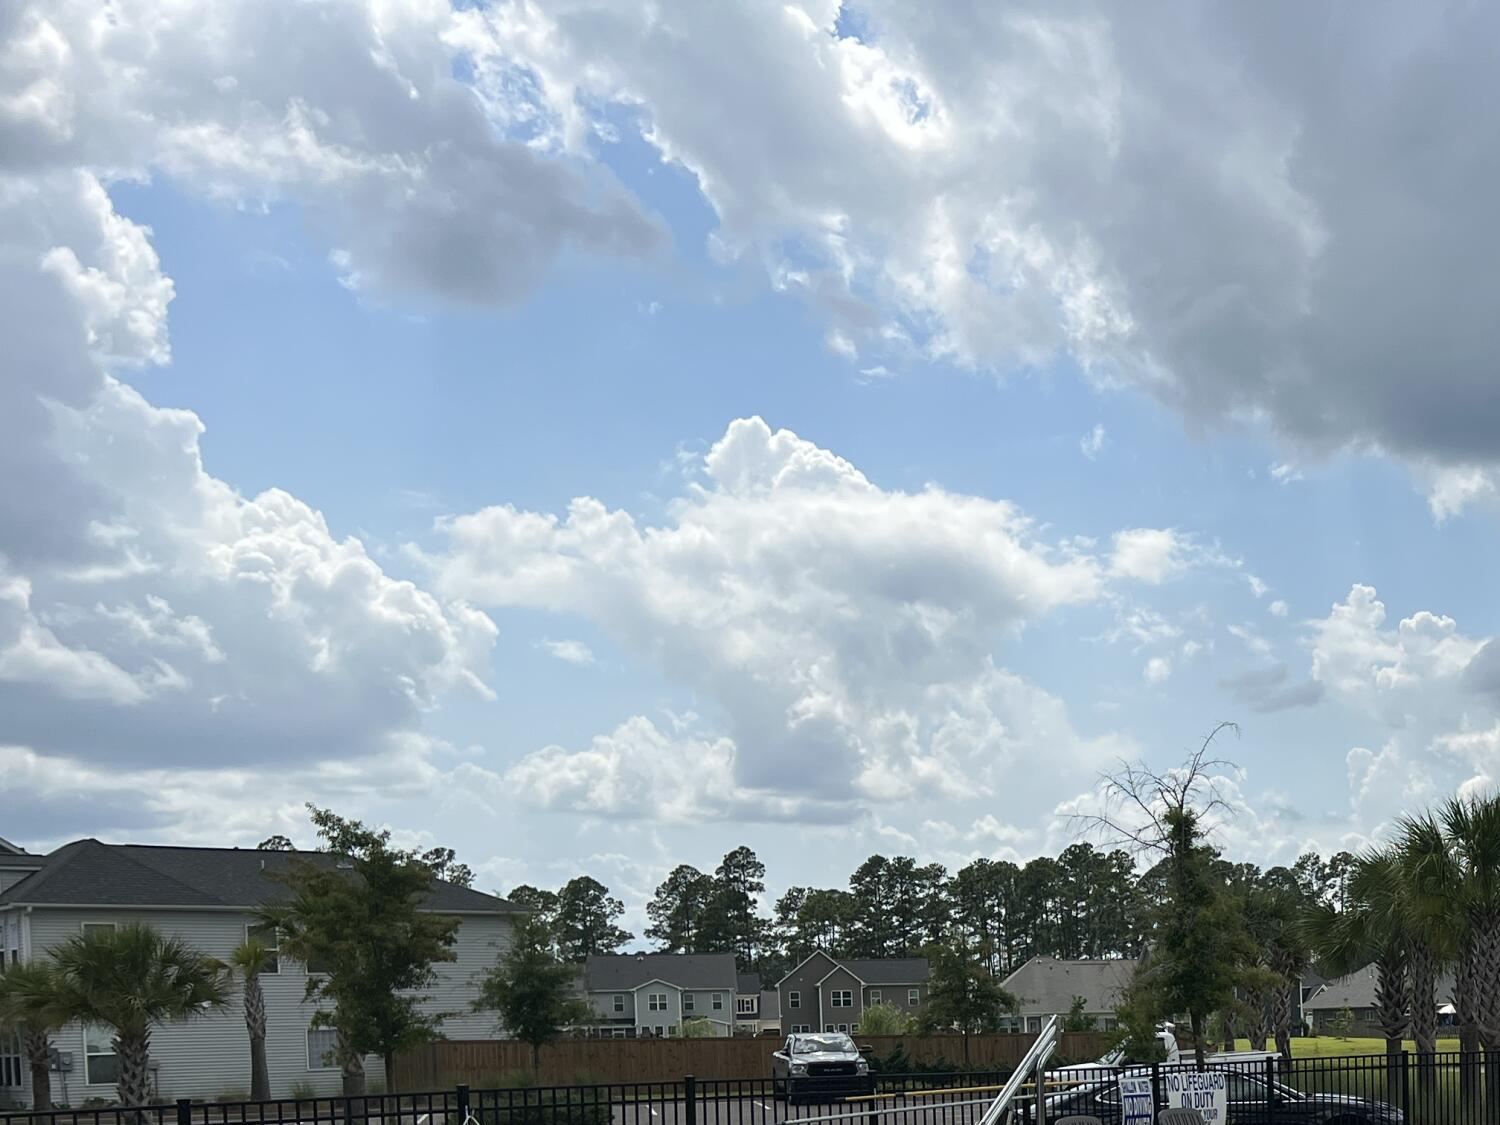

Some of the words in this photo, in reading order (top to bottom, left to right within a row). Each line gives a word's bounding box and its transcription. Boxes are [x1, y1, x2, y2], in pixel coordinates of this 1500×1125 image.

[1167, 1075, 1180, 1092] NO
[1181, 1074, 1225, 1091] LIFEGUARD
[1125, 1097, 1134, 1116] NO
[1134, 1096, 1152, 1115] DIVING
[1181, 1093, 1193, 1109] ON
[1195, 1092, 1214, 1108] DUTY
[1203, 1109, 1218, 1120] YOUR
